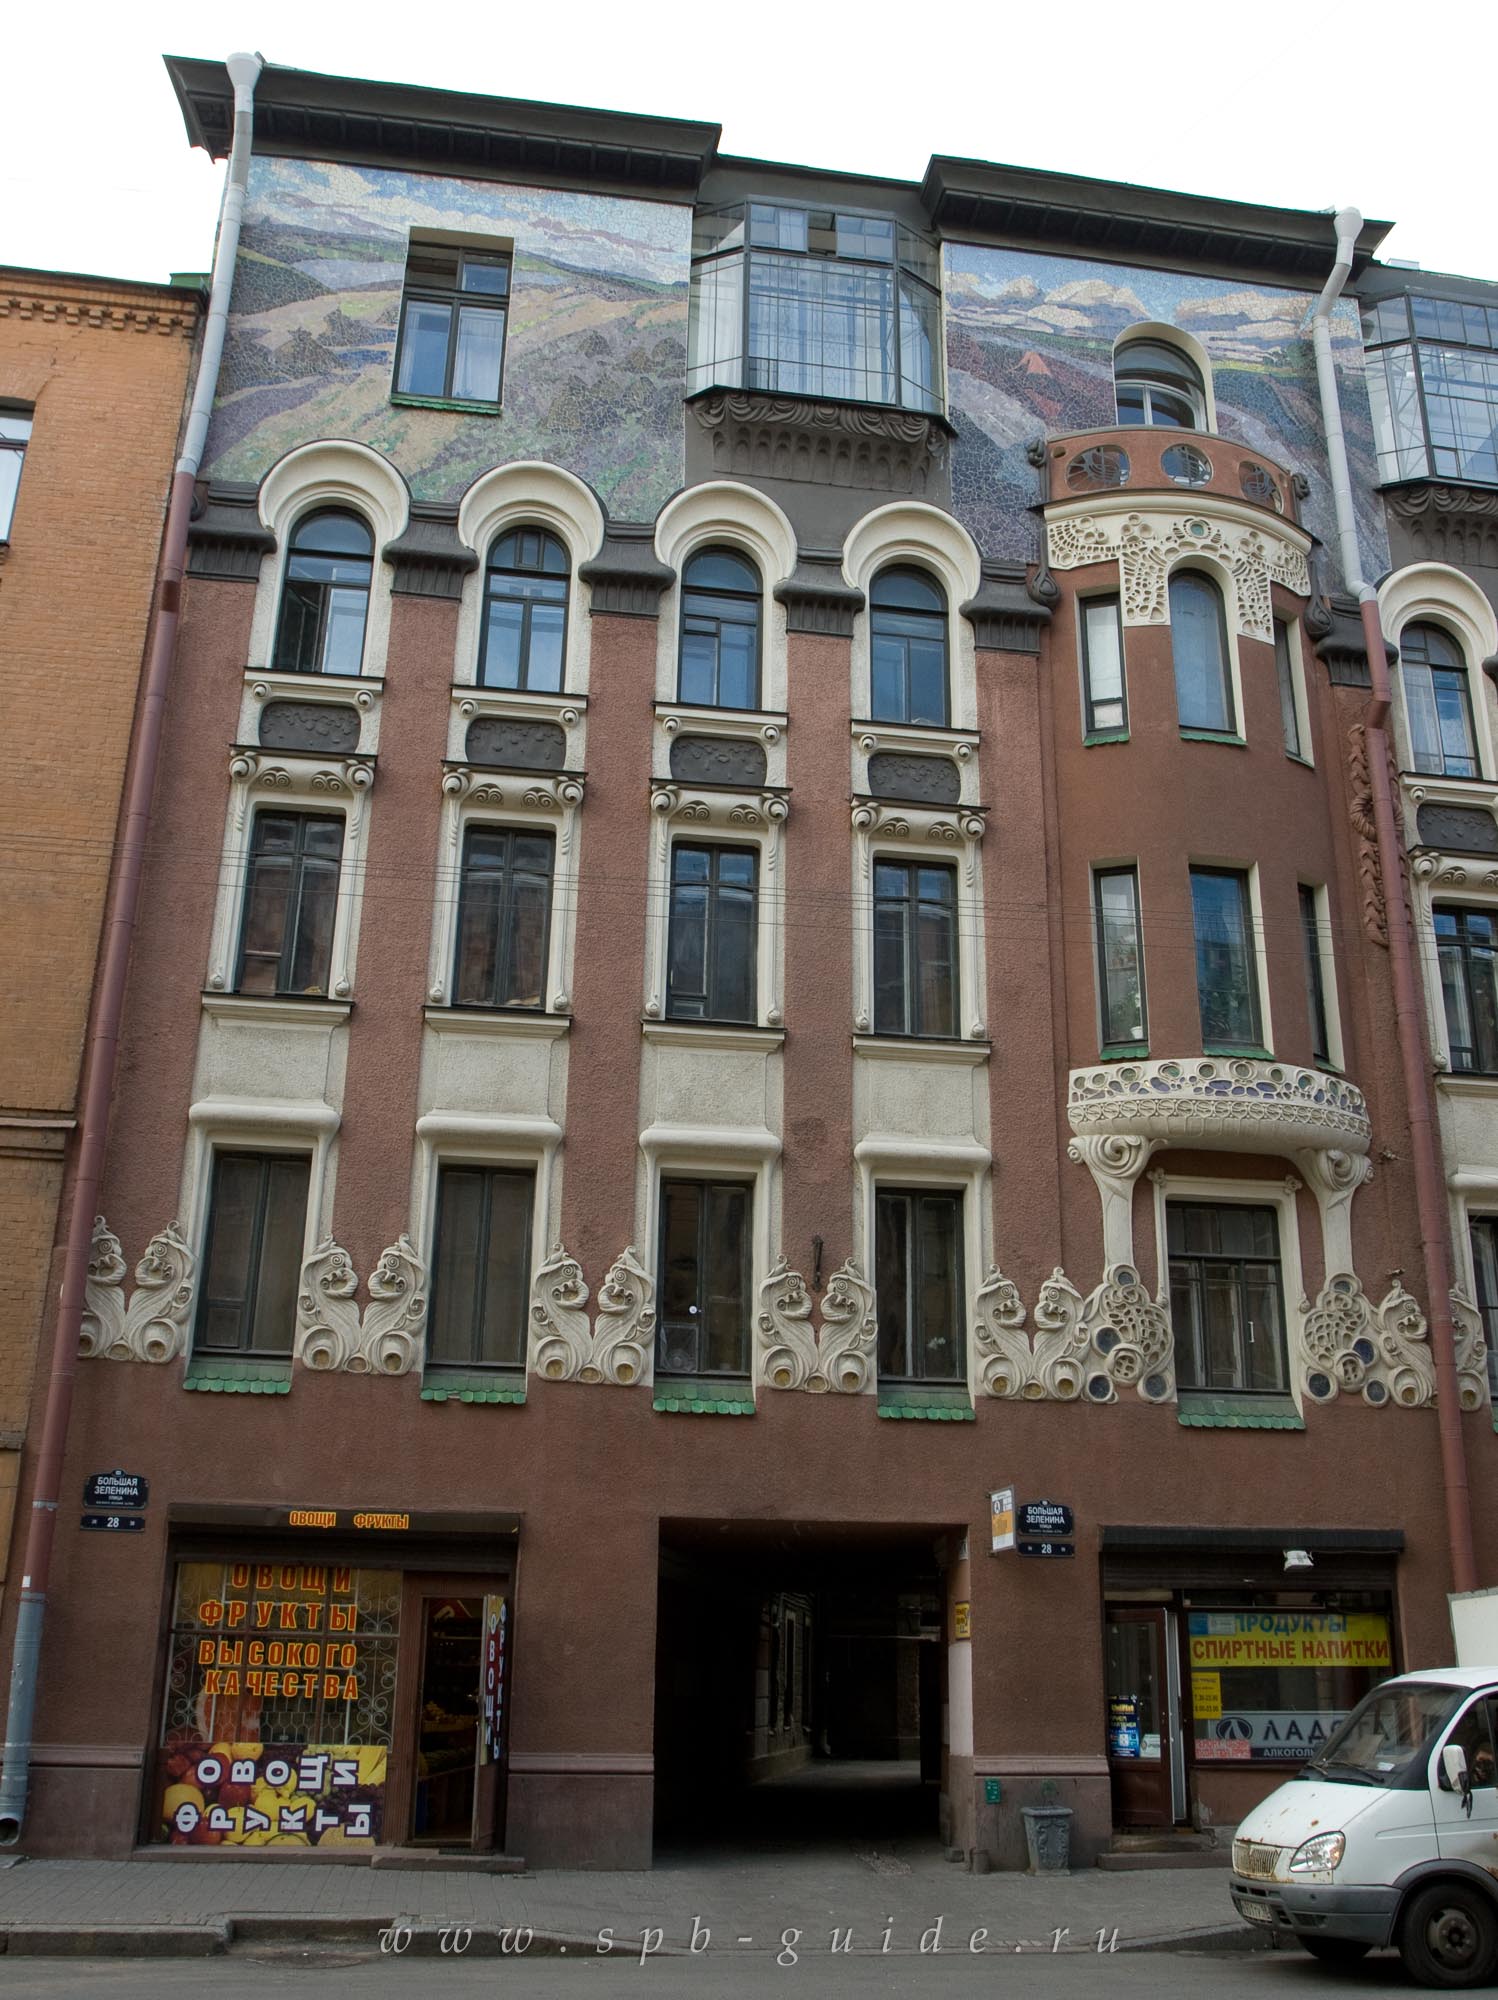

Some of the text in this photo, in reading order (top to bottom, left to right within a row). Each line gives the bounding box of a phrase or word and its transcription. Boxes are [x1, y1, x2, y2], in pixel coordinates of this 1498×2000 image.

[97, 1476, 138, 1486] БОЛЬШАЯ
[94, 1486, 138, 1496] ЗЕЛЕНИНА
[1026, 1515, 1065, 1524] ЗЕЛЕНИНА
[1027, 1506, 1063, 1515] БОЛЬШАЯ
[106, 1517, 120, 1527] 28
[289, 1511, 409, 1529] ОВОЩИ ФРУКТЫ
[1041, 1543, 1052, 1554] 28
[231, 1563, 351, 1595] ОВОЩИ
[199, 1599, 357, 1631] ФРУКТЫ
[198, 1640, 357, 1669] ВЫСОКОГО
[1192, 1640, 1390, 1659] СПИРТНЫЕ НАПИТКИ
[205, 1669, 359, 1700] КАЧЕСТВА
[196, 1753, 359, 1790] ОВОЩИ
[174, 1802, 373, 1836] ФРУКТЫ
